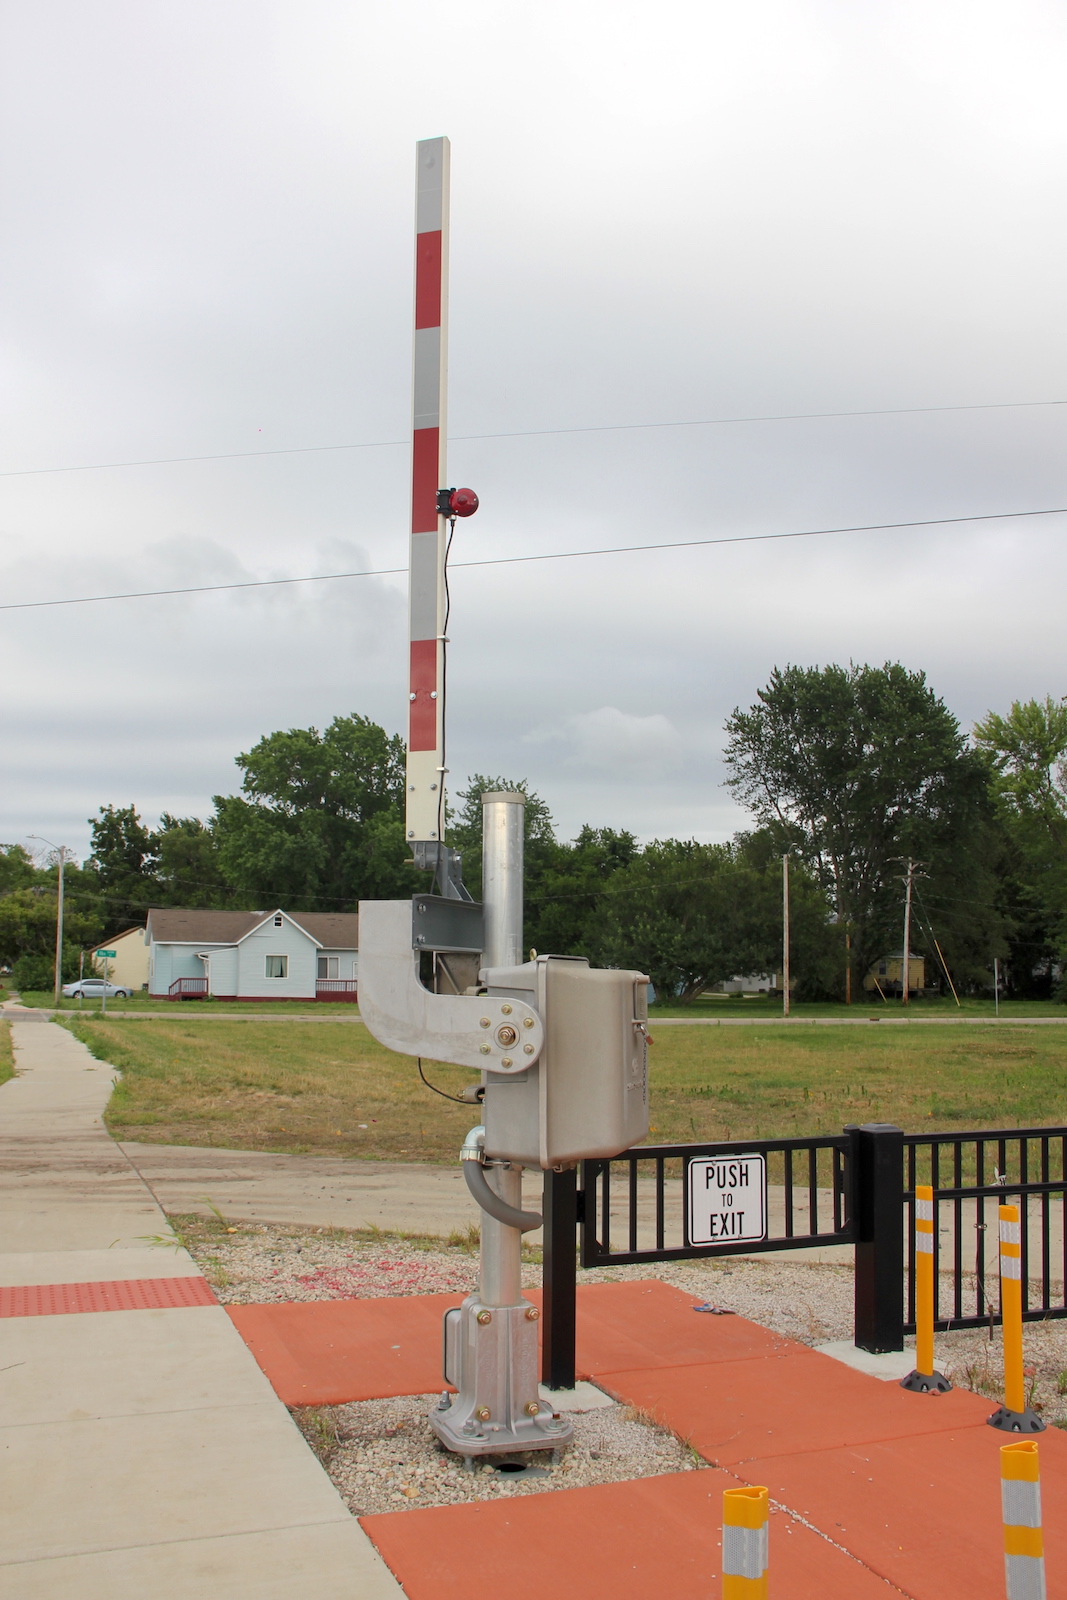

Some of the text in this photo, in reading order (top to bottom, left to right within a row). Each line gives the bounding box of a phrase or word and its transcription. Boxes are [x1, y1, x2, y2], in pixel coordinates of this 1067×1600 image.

[705, 1164, 749, 1190] PUSH
[721, 1193, 733, 1207] TO
[710, 1211, 745, 1237] EXIT
